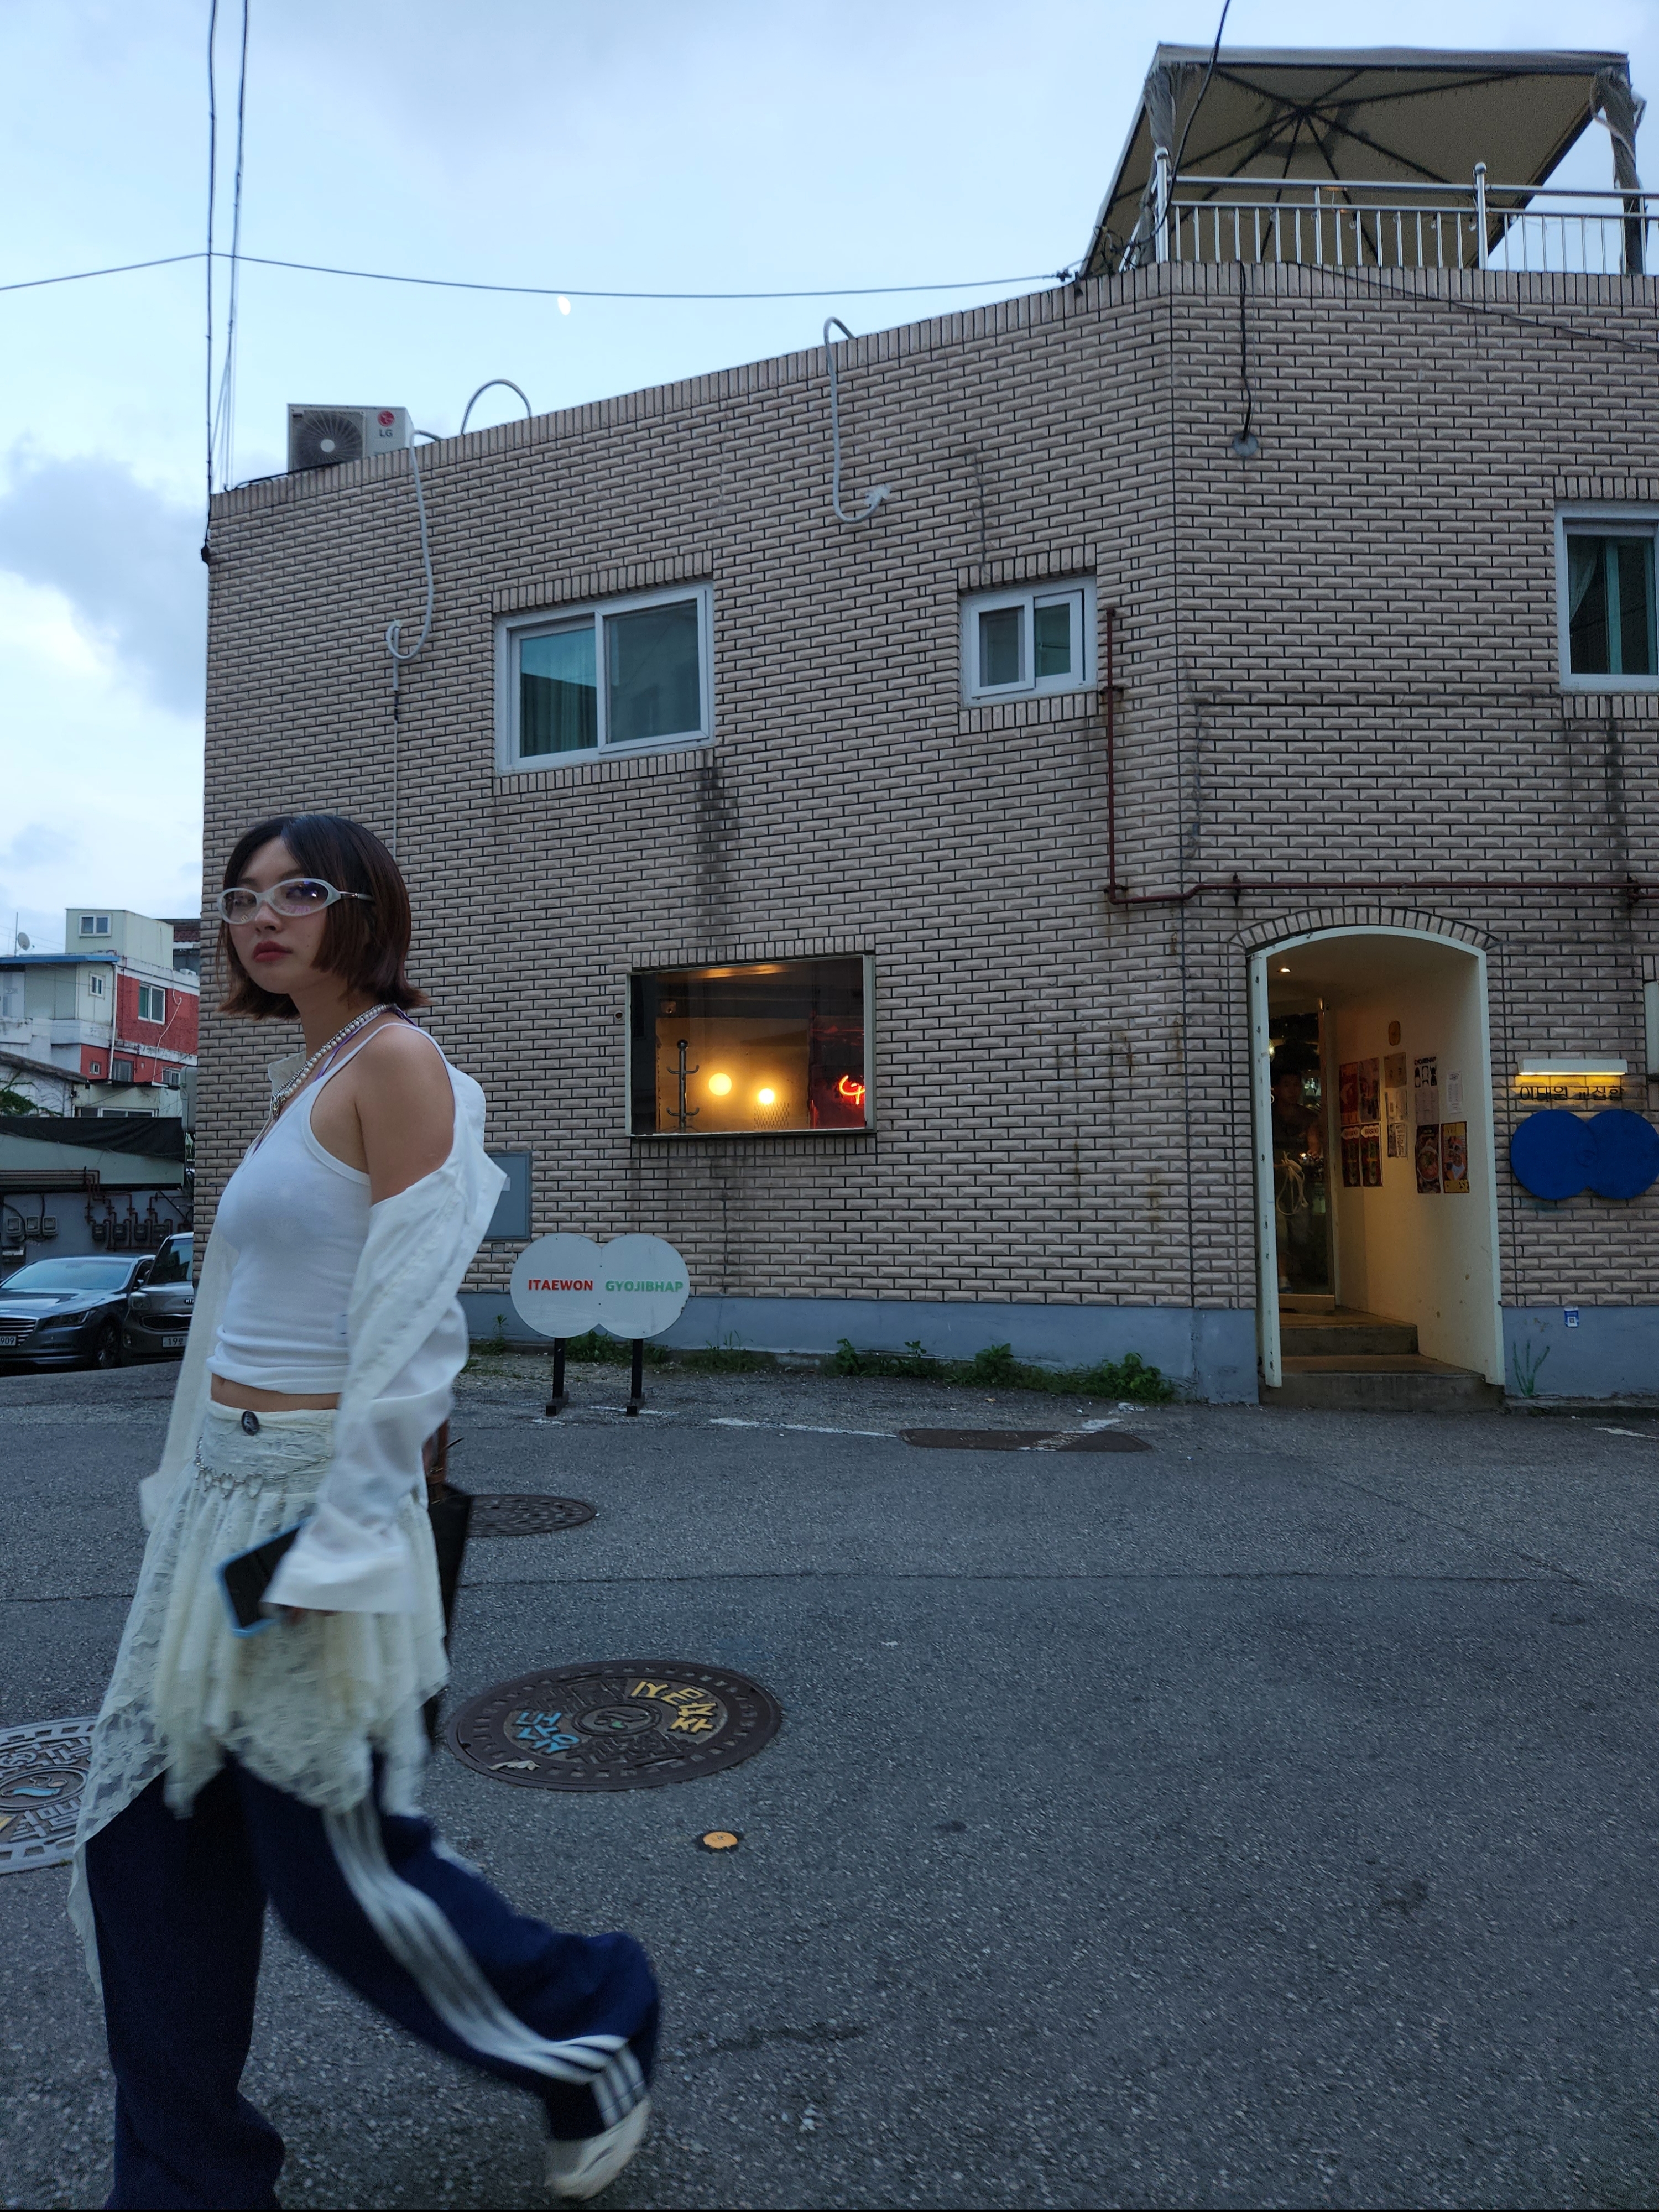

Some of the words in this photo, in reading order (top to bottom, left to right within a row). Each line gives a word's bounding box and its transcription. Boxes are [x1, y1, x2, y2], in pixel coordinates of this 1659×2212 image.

[379, 429, 393, 437] LG
[1520, 1086, 1567, 1101] 이태원
[1574, 1086, 1624, 1101] 교집합
[528, 1279, 593, 1291] ITAEWON
[605, 1280, 684, 1293] GYOJIBHAP
[628, 1681, 717, 1734] 주차금지
[517, 1712, 580, 1755] 상수도
